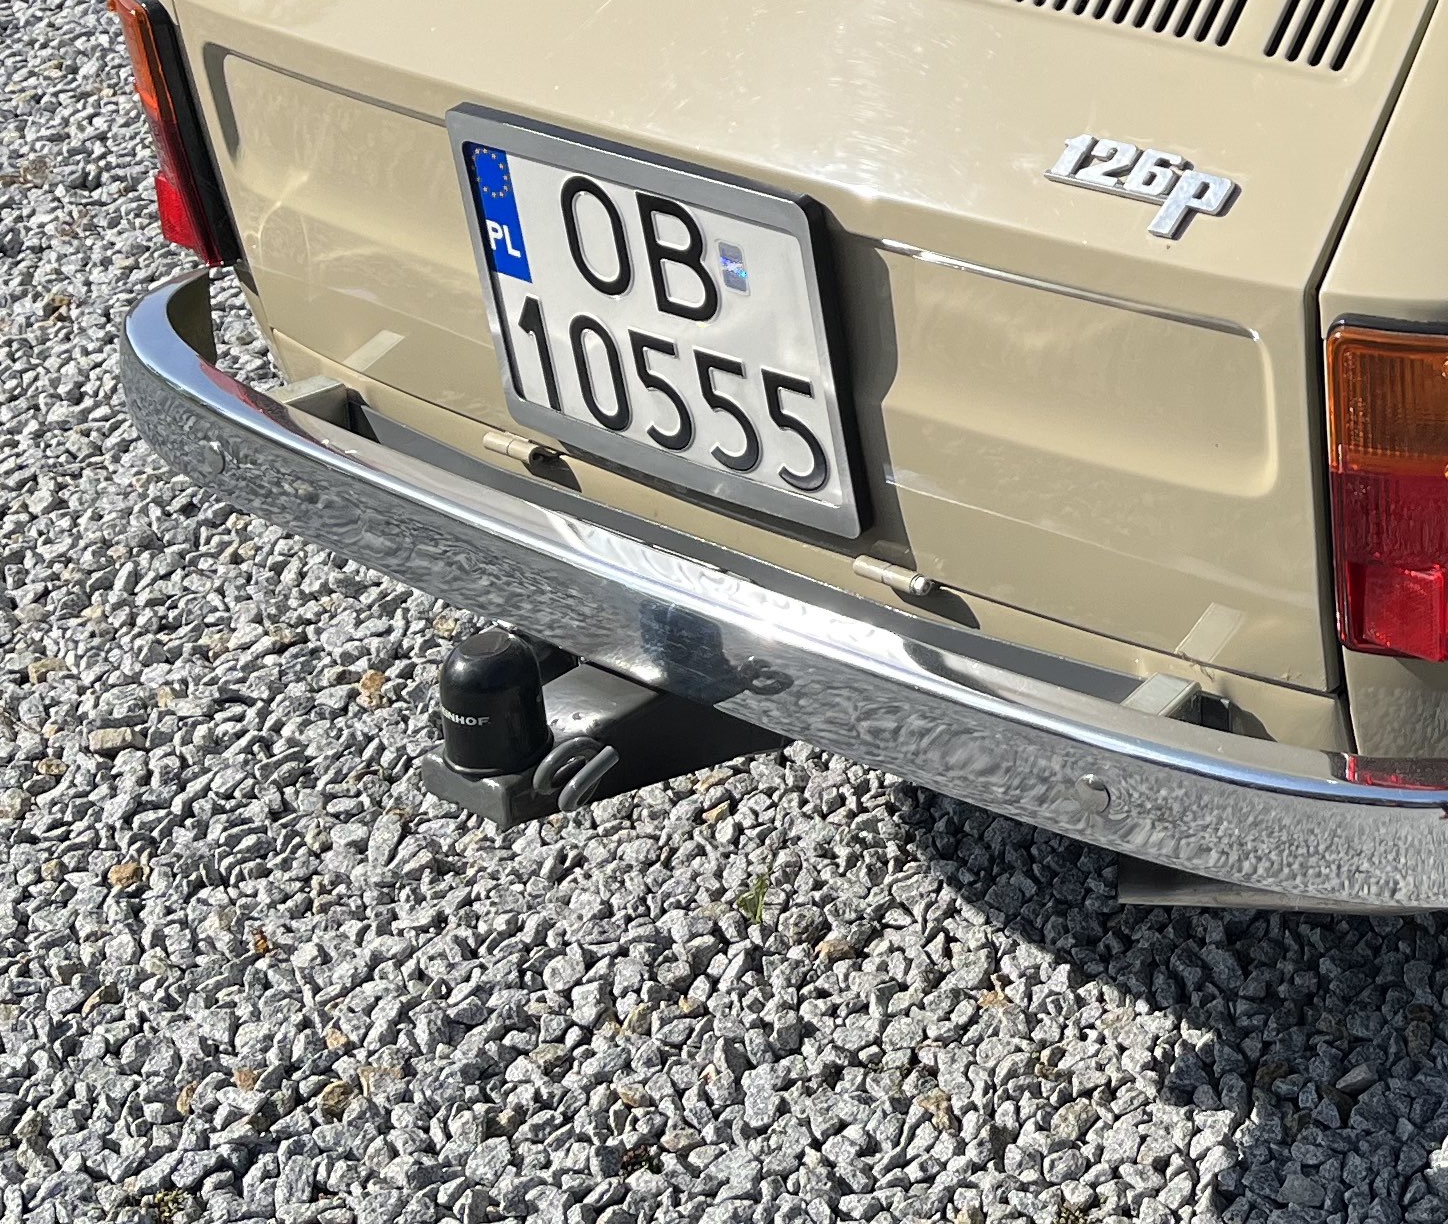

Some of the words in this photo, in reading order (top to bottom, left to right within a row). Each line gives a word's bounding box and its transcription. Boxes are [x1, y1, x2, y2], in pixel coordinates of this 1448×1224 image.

[486, 219, 522, 258] PL
[560, 175, 719, 323] OB
[518, 294, 829, 493] 10555
